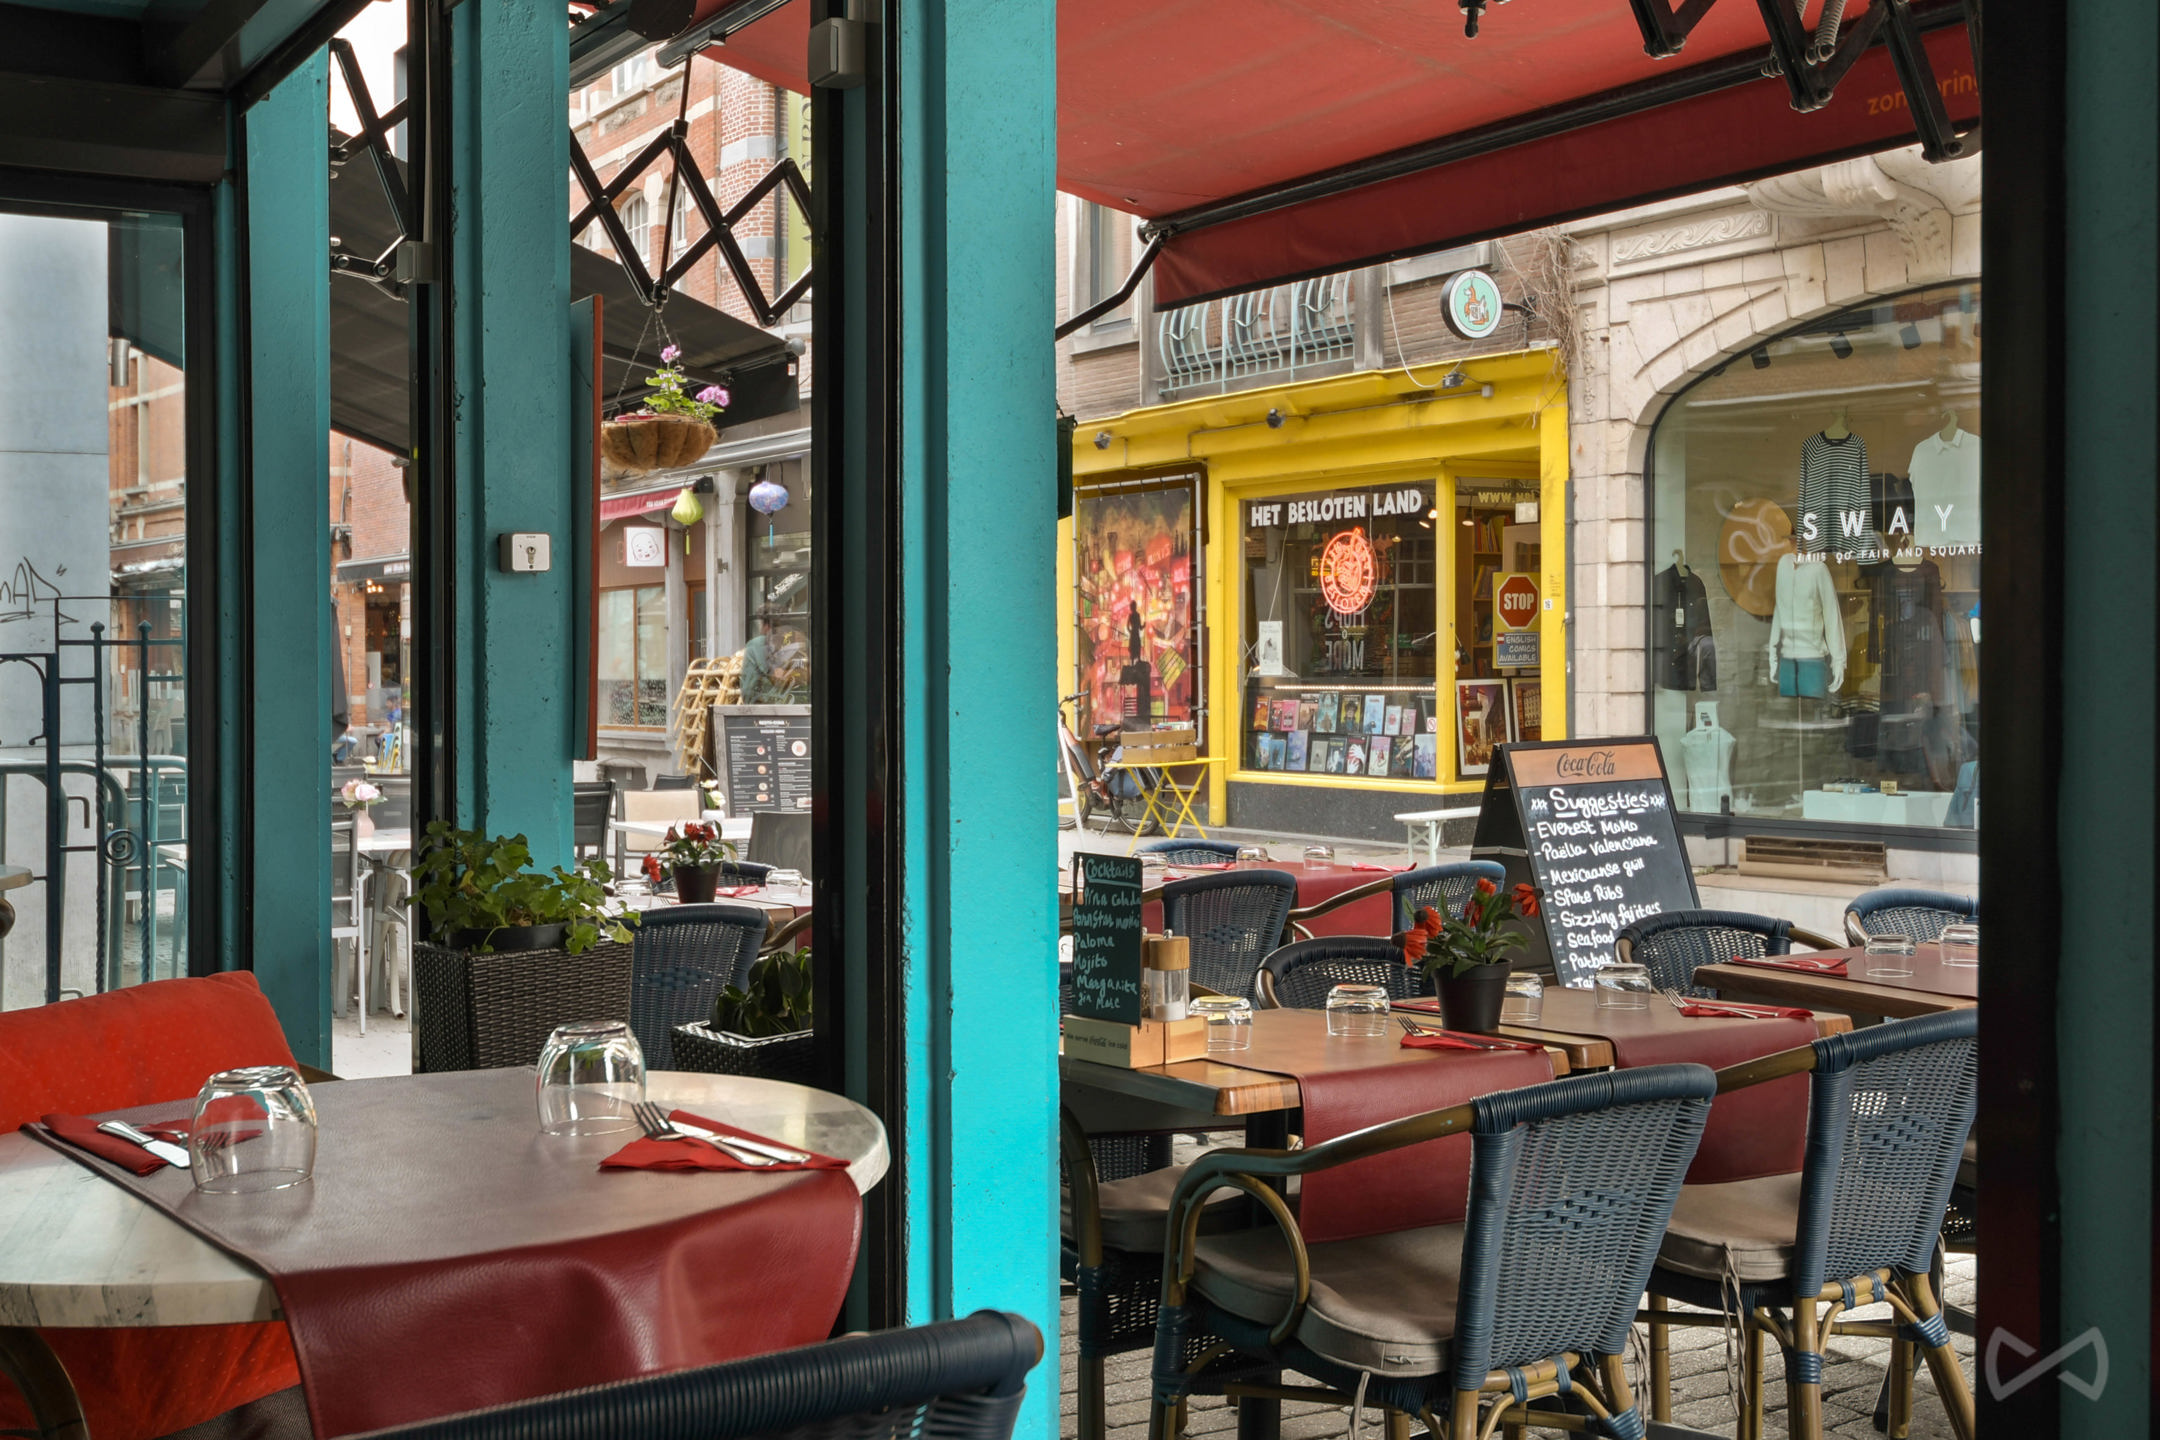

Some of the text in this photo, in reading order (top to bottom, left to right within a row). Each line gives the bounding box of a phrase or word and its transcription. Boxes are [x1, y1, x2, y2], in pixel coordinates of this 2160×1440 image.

[1251, 489, 1421, 527] HET BESLOTEN LAND
[1803, 504, 1954, 540] SWAY
[1861, 543, 1982, 559] FAIR AND SQUARE
[1503, 592, 1535, 611] STOP
[1506, 635, 1536, 643] ENGLISH
[1509, 645, 1536, 653] COMICS
[1499, 653, 1537, 662] AVAILABLE
[1549, 787, 1649, 818] Suggesties
[1085, 858, 1136, 881] Cocktails
[1550, 862, 1621, 886] Mexicaanse
[1593, 884, 1624, 902] Ribs
[1560, 909, 1619, 930] Sizzling
[1073, 931, 1115, 951] Paloma
[1567, 929, 1616, 949] Seafood
[1073, 953, 1108, 974] Mojito
